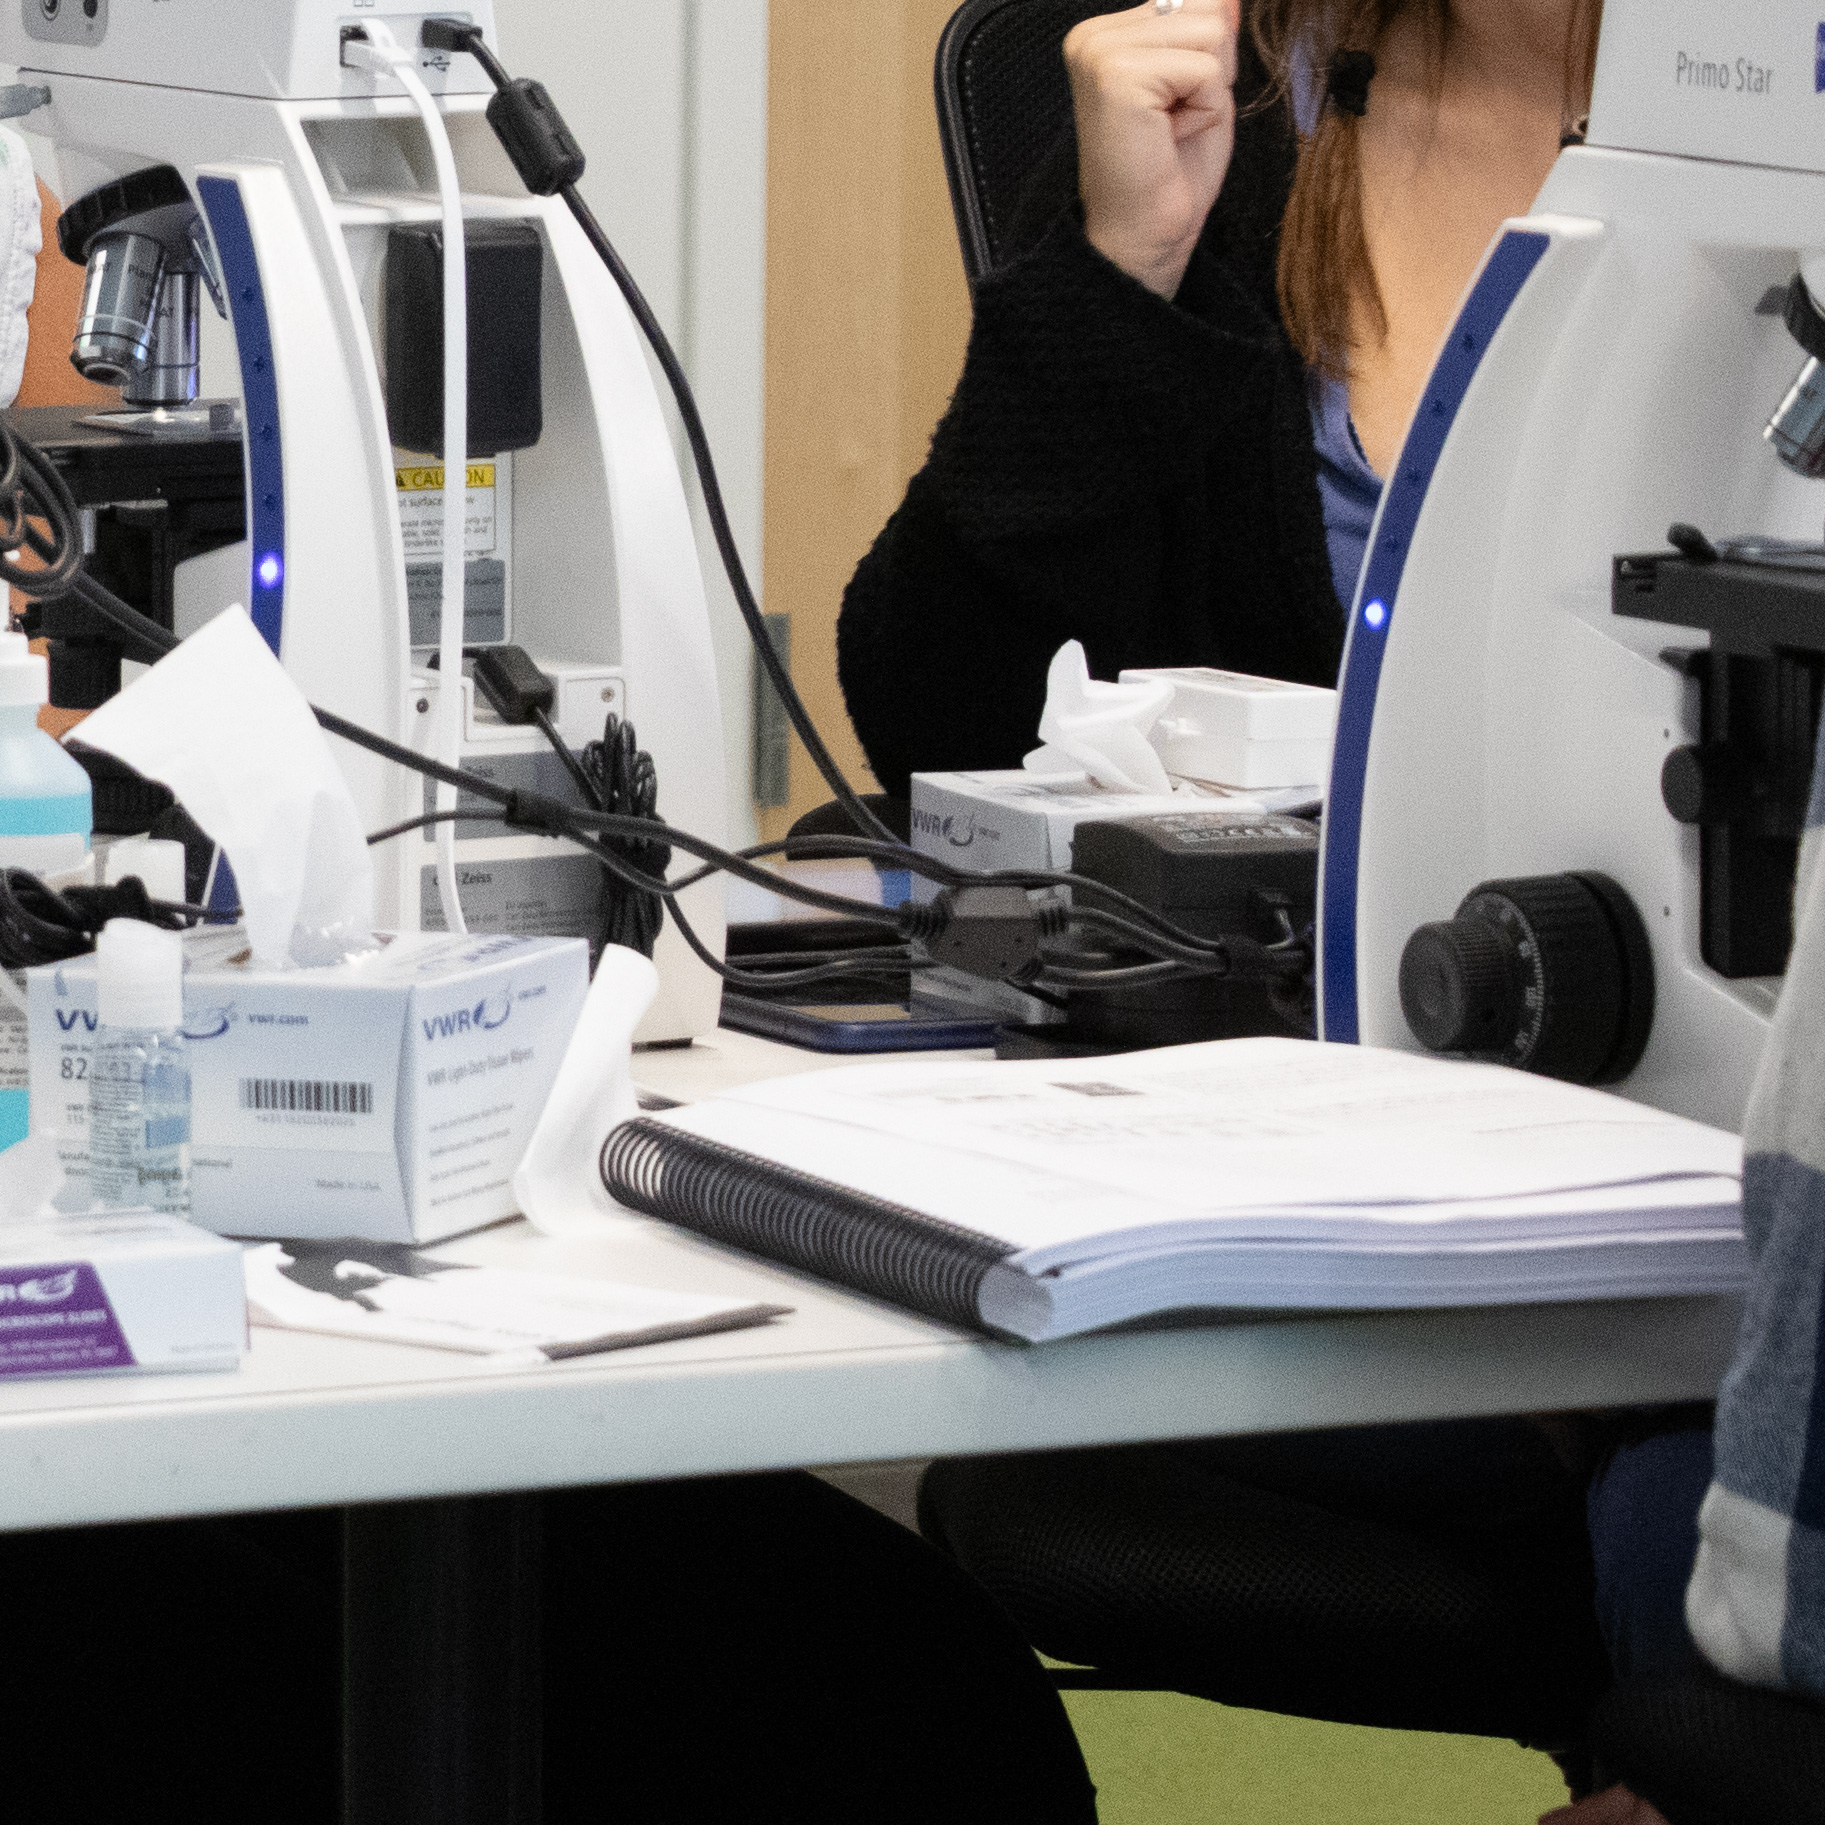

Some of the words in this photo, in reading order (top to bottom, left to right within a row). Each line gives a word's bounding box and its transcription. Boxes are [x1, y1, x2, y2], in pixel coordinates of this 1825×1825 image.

[1676, 51, 1729, 89] Primo
[1735, 57, 1774, 94] Star
[911, 807, 942, 837] VWR
[461, 871, 493, 886] Zeiss
[248, 1013, 309, 1026] vwr.com
[422, 1008, 472, 1042] VWR
